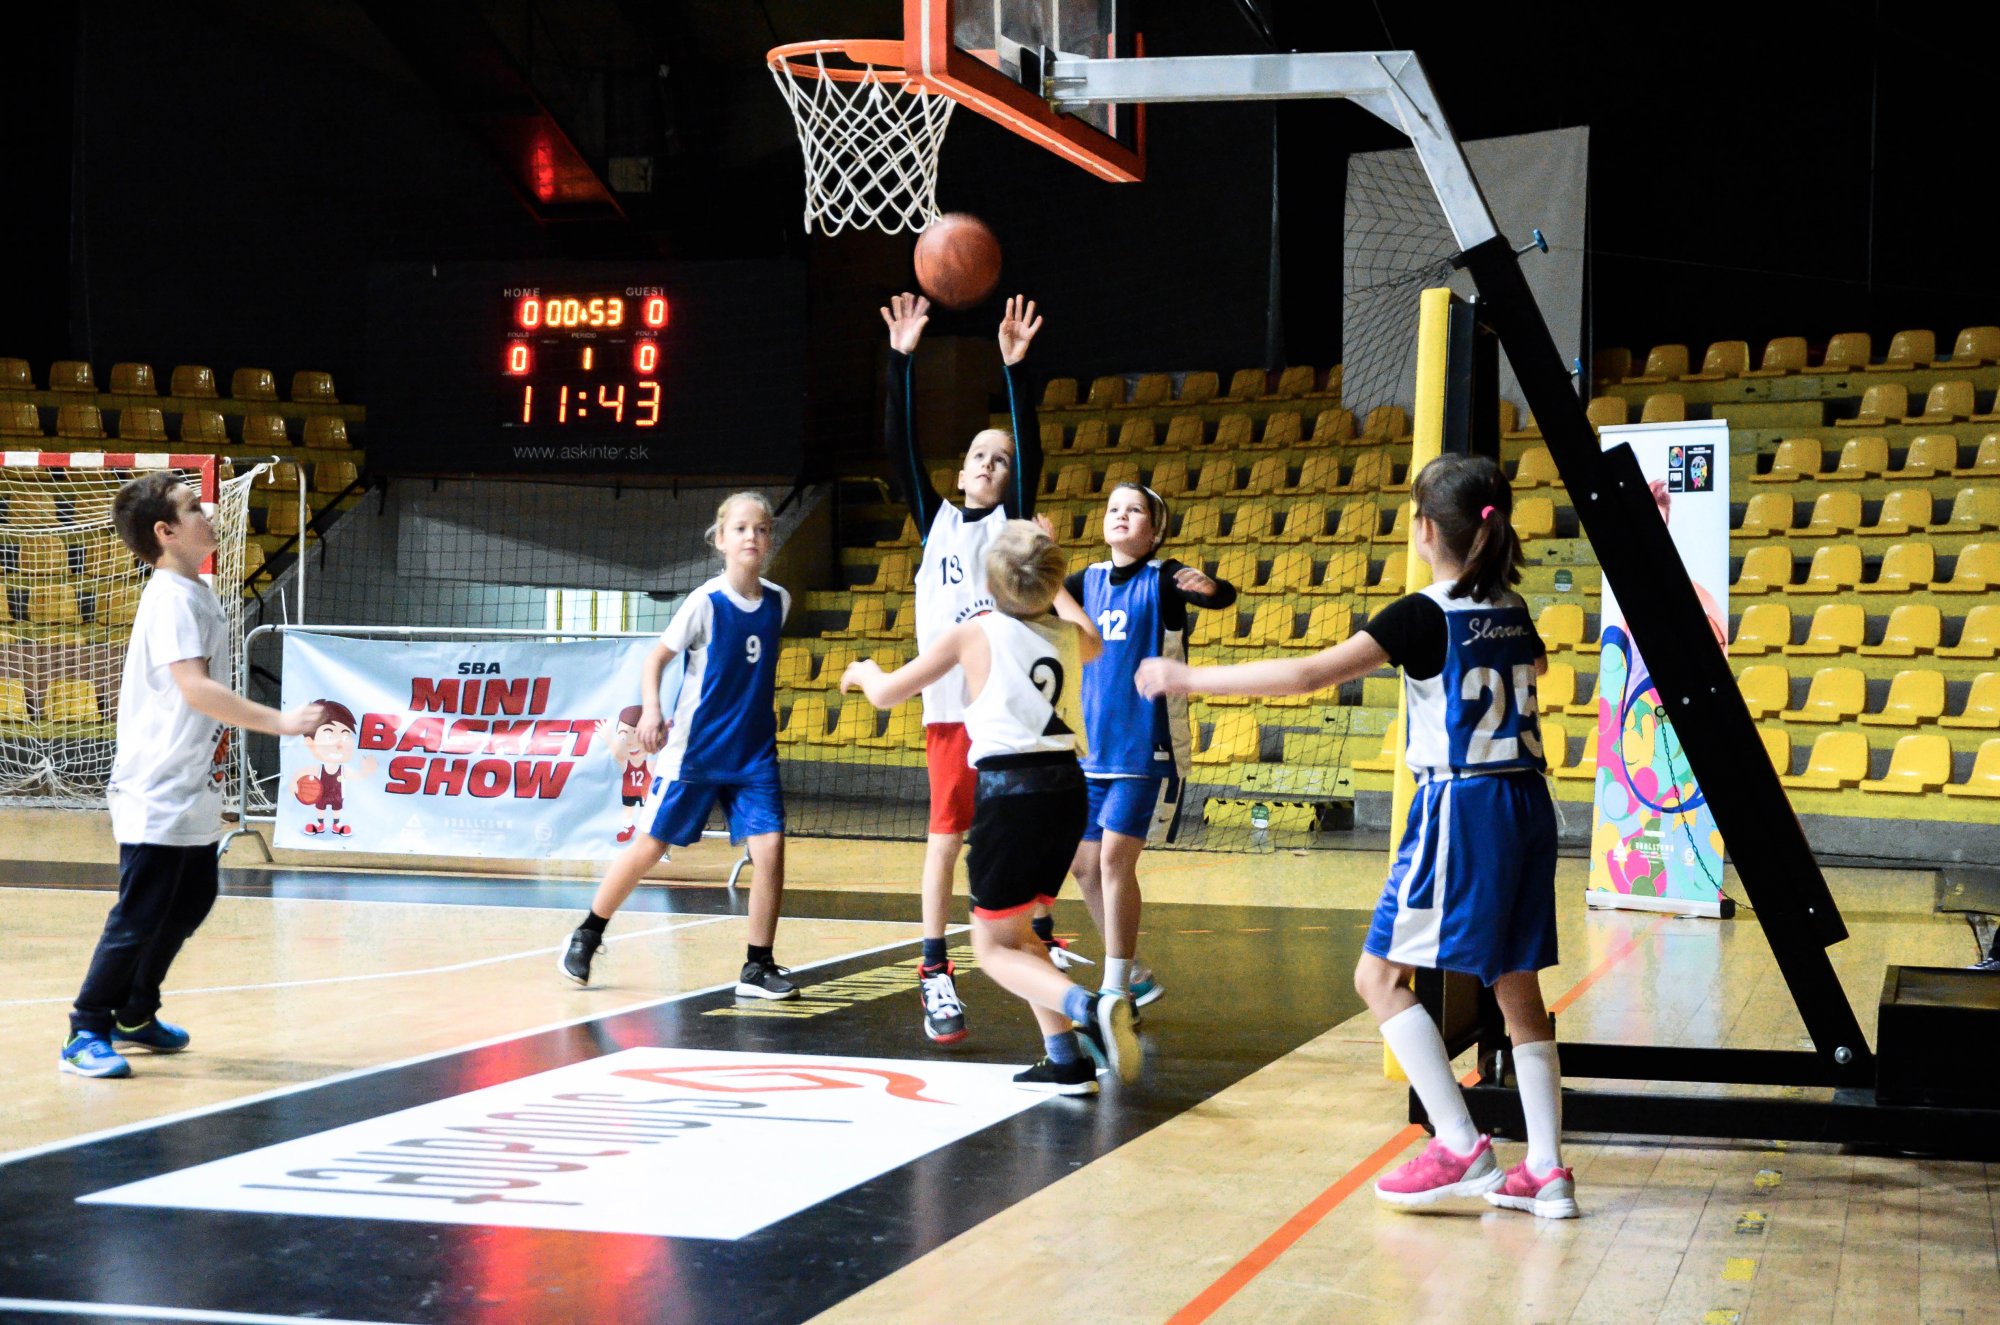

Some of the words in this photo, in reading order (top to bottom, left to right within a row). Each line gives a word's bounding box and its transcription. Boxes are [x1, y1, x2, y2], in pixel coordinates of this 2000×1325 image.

[503, 287, 541, 298] HOME
[625, 286, 664, 298] GUEST
[522, 300, 539, 326] 0
[648, 299, 664, 325] 0
[512, 346, 527, 372] 0
[583, 347, 592, 370] 1
[639, 345, 655, 370] 0
[523, 381, 661, 426] 11:43
[513, 444, 649, 461] www.askinter.sk
[1097, 609, 1127, 641] 12
[745, 634, 762, 664] 9
[458, 662, 501, 675] SBA
[409, 677, 551, 716] MINI
[1029, 656, 1075, 736] 2
[1461, 664, 1542, 764] 25
[358, 712, 607, 758] BASKET
[385, 755, 575, 800] SHOW
[630, 770, 645, 787] 12
